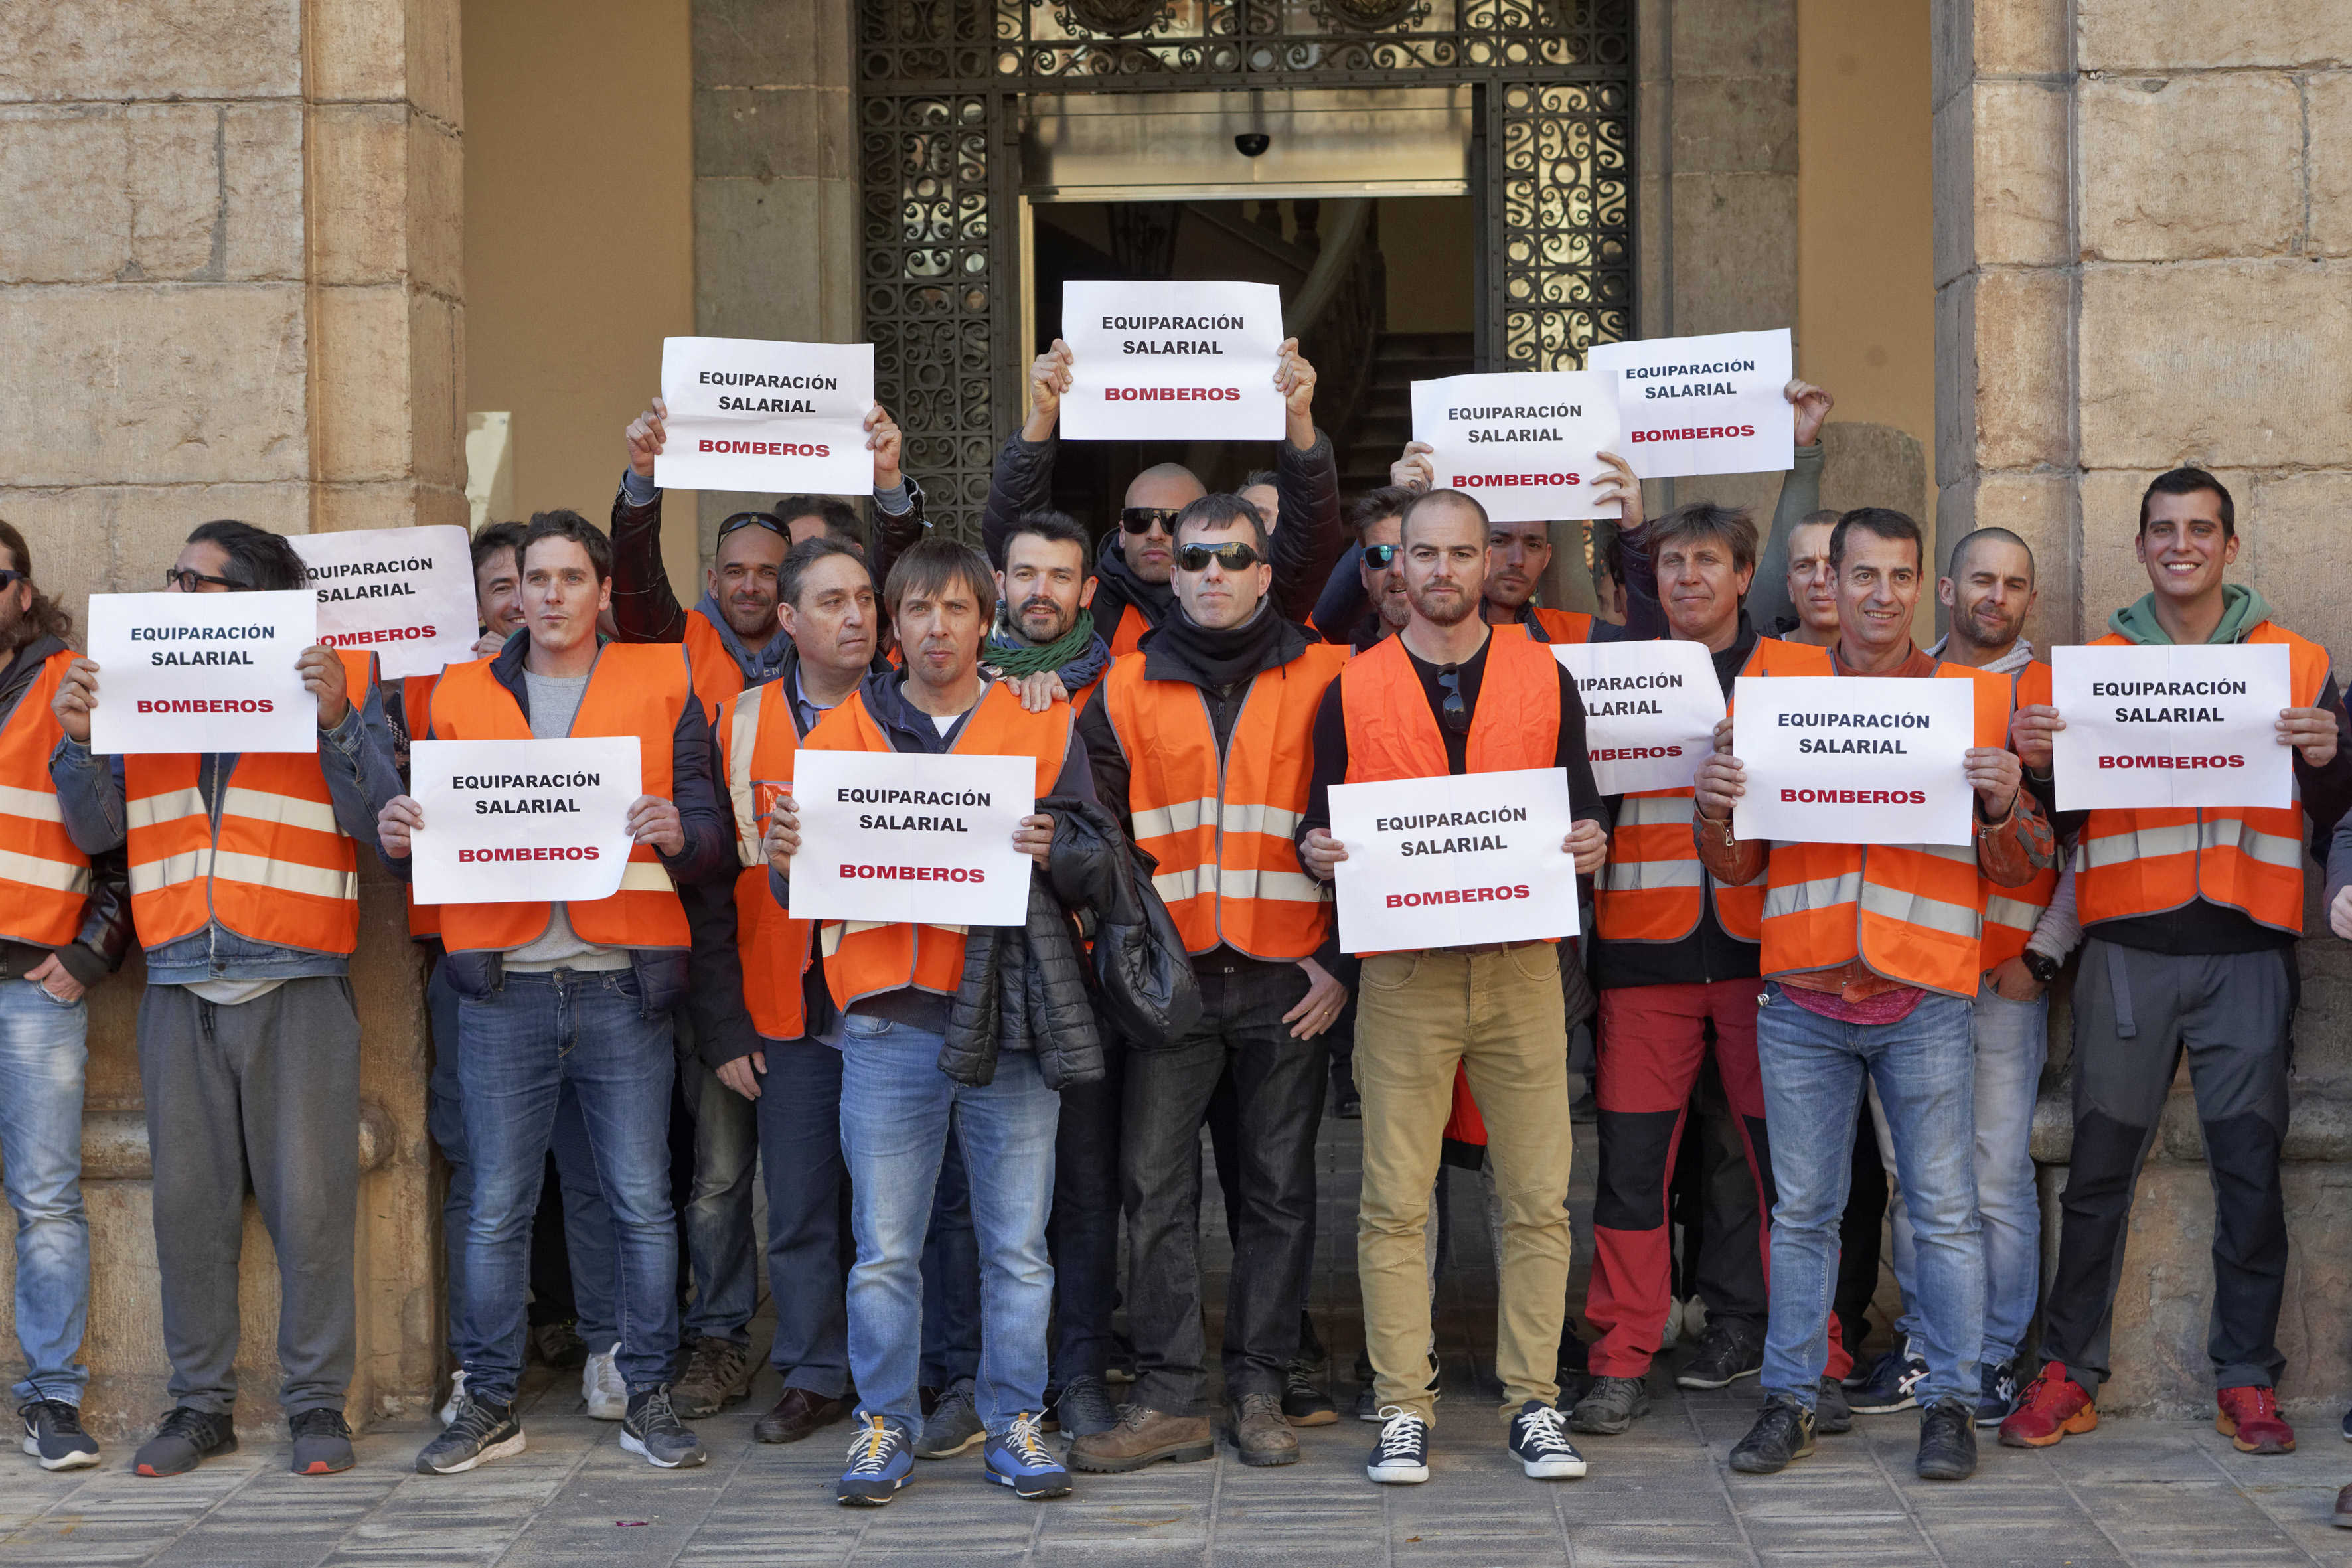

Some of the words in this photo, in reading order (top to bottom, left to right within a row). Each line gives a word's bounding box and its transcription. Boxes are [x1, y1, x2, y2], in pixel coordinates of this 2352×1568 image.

[1103, 314, 1243, 330] EQUIPARACIÓN
[1123, 341, 1223, 354] SALARIAL
[1626, 361, 1754, 379] EQUIPARACIÓN
[700, 372, 836, 390] EQUIPARACIÓN
[1105, 388, 1240, 400] BOMBEROS
[1646, 382, 1737, 399] SALARIAL
[719, 396, 815, 412] SALARIAL
[1449, 403, 1581, 420] EQUIPARACIÓN
[1469, 429, 1563, 443] SALARIAL
[1632, 425, 1754, 443] BOMBEROS
[699, 440, 829, 457] BOMBEROS
[1453, 473, 1580, 487] BOMBEROS
[307, 556, 433, 580] QUIPARACIÓN
[317, 582, 416, 603] SALARIAL
[131, 624, 274, 641] EQUIPARACIÓN
[316, 625, 437, 650] OMBEROS
[152, 651, 253, 665] SALARIAL
[1573, 672, 1682, 692] IPARACIÓN
[2093, 678, 2245, 696] EQUIPARACIÓN
[137, 700, 273, 712] BOMBEROS
[1582, 700, 1663, 717] LARIAL
[1778, 712, 1929, 728] EQUIPARACIÓN
[2116, 708, 2224, 722] SALARIAL
[1587, 746, 1683, 762] MBEROS
[1800, 739, 1907, 754] SALARIAL
[2099, 755, 2244, 769] BOMBEROS
[453, 771, 600, 789] EQUIPARACIÓN
[838, 789, 990, 806] EQUIPARACIÓN
[1781, 789, 1925, 803] BOMBEROS
[476, 799, 580, 814] SALARIAL
[860, 815, 967, 832] SALARIAL
[1377, 806, 1526, 831] EQUIPARACIÓN
[1401, 835, 1507, 856] SALARIAL
[459, 847, 599, 862] BOMBEROS
[840, 864, 984, 882] BOMBEROS
[1386, 885, 1529, 908] BOMBEROS
